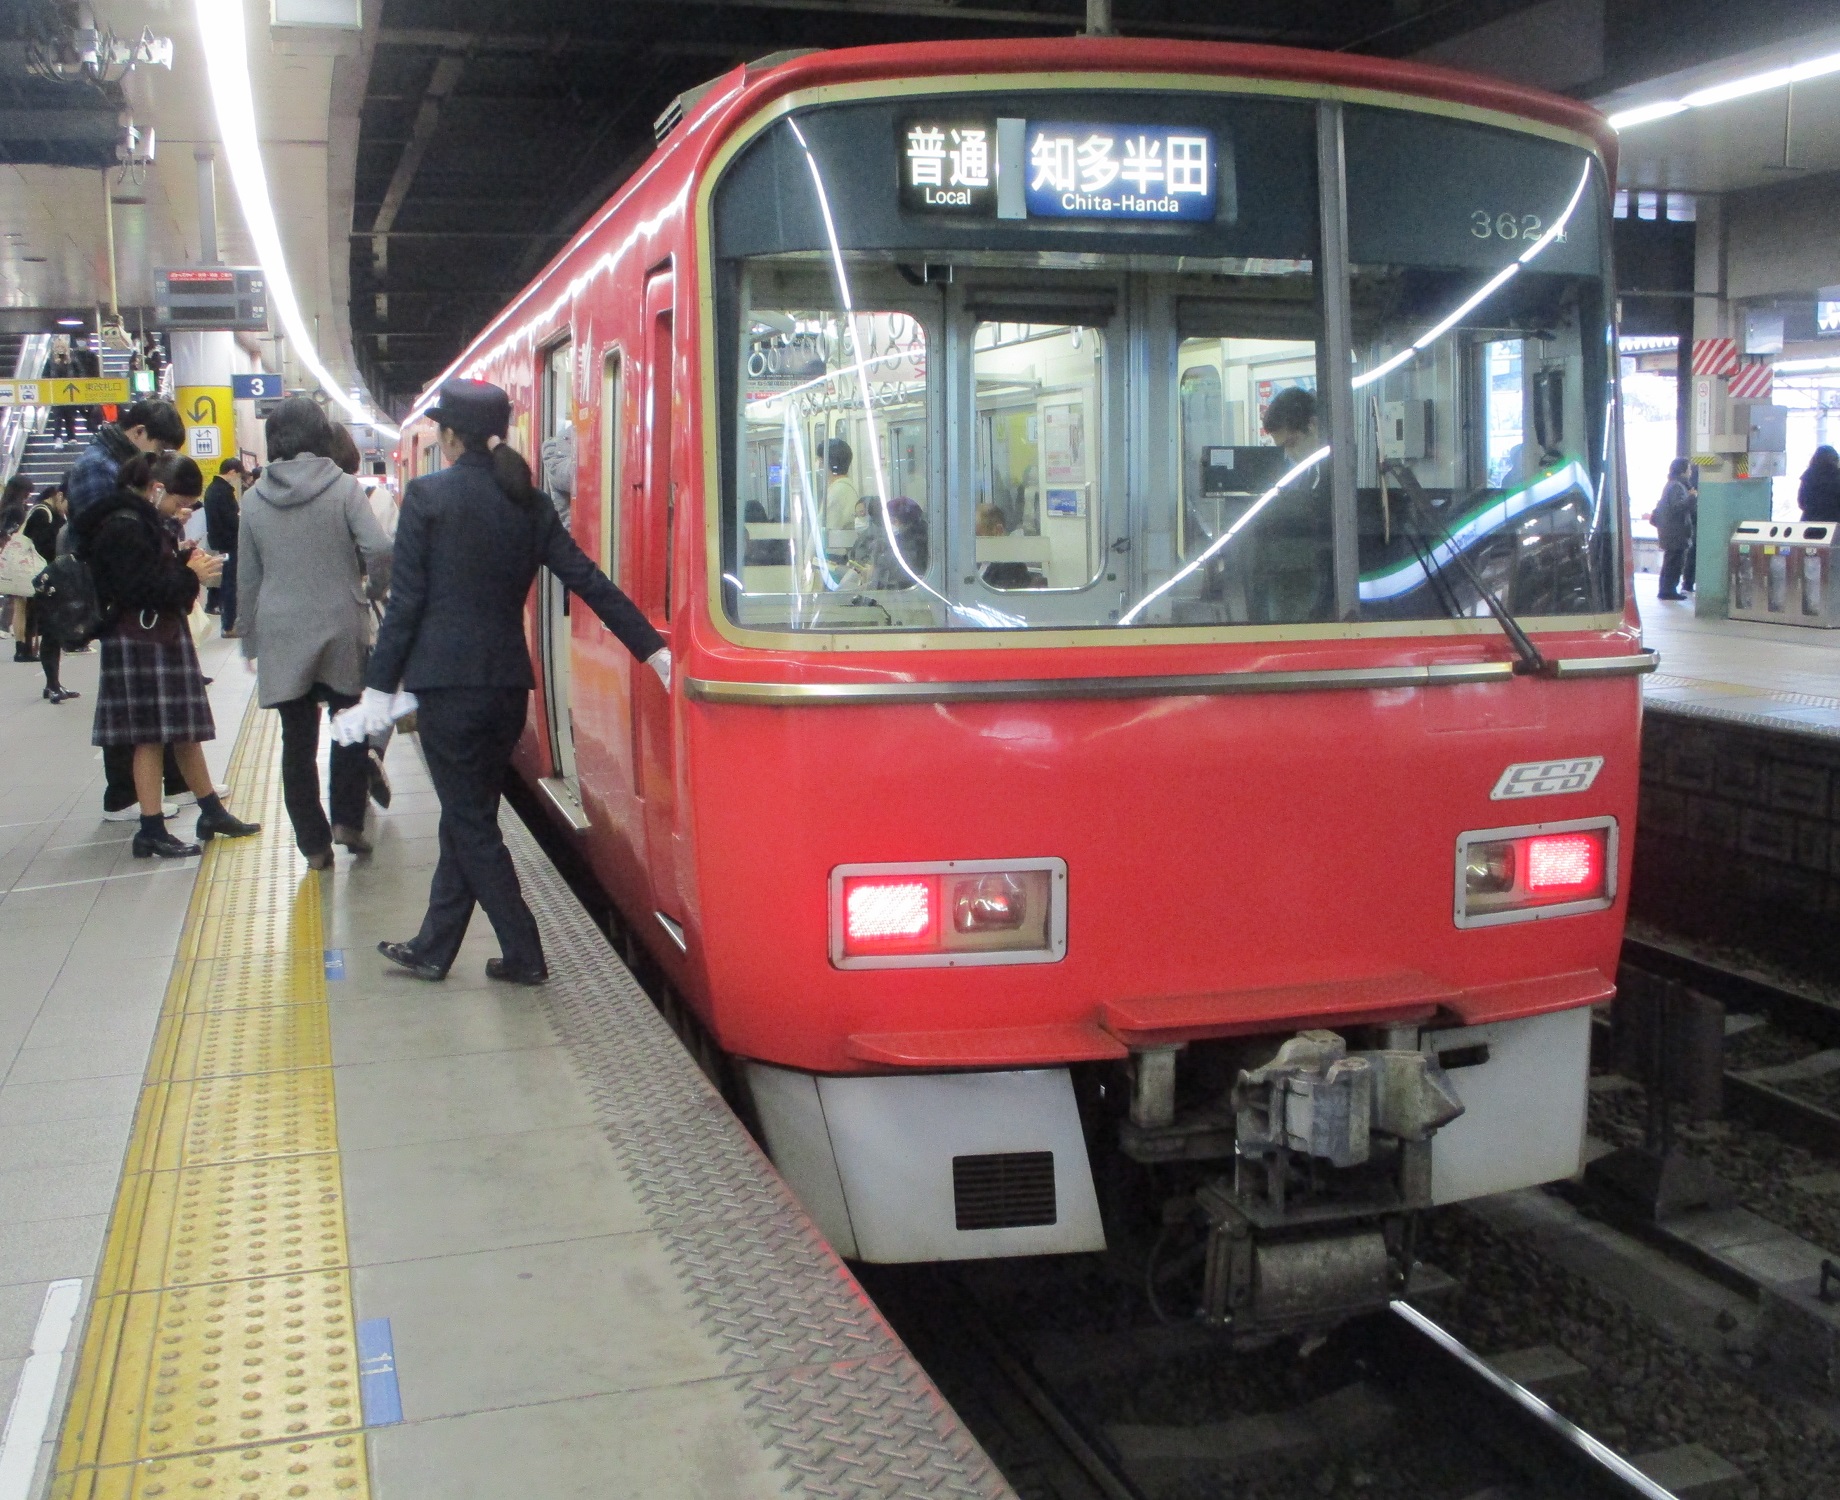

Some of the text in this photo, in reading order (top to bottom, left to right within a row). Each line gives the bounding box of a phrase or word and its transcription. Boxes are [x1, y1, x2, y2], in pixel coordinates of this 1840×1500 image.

[907, 126, 990, 187] 普通
[1031, 133, 1208, 196] 知多半田
[926, 188, 971, 205] Local
[1062, 193, 1179, 212] Chita-Handa
[251, 378, 265, 396] 3
